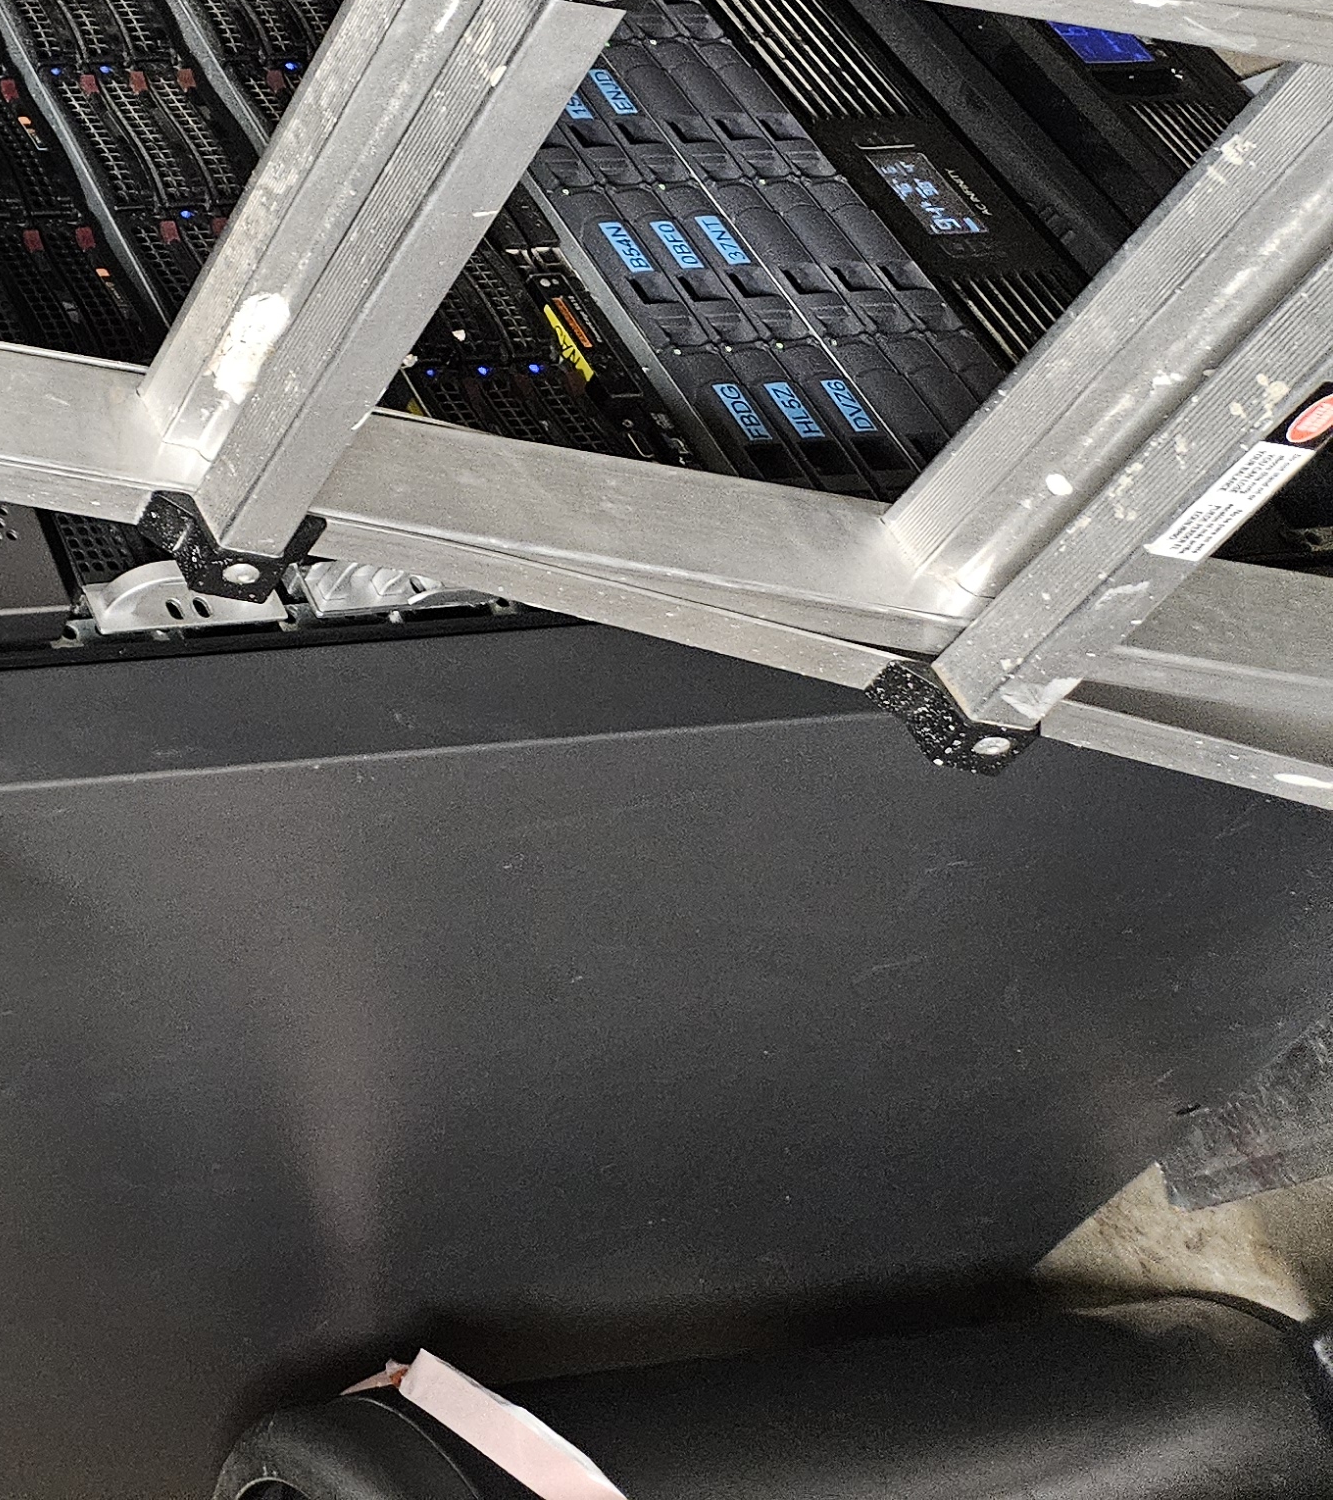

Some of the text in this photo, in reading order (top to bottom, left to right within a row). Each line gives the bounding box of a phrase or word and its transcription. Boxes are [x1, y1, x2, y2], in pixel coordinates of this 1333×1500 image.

[595, 72, 633, 111] ENJD
[606, 226, 649, 269] B54N
[703, 219, 745, 260] 37NT
[721, 386, 769, 438] FBDG
[772, 387, 820, 433] HL5Z
[827, 381, 874, 429] DVZ6
